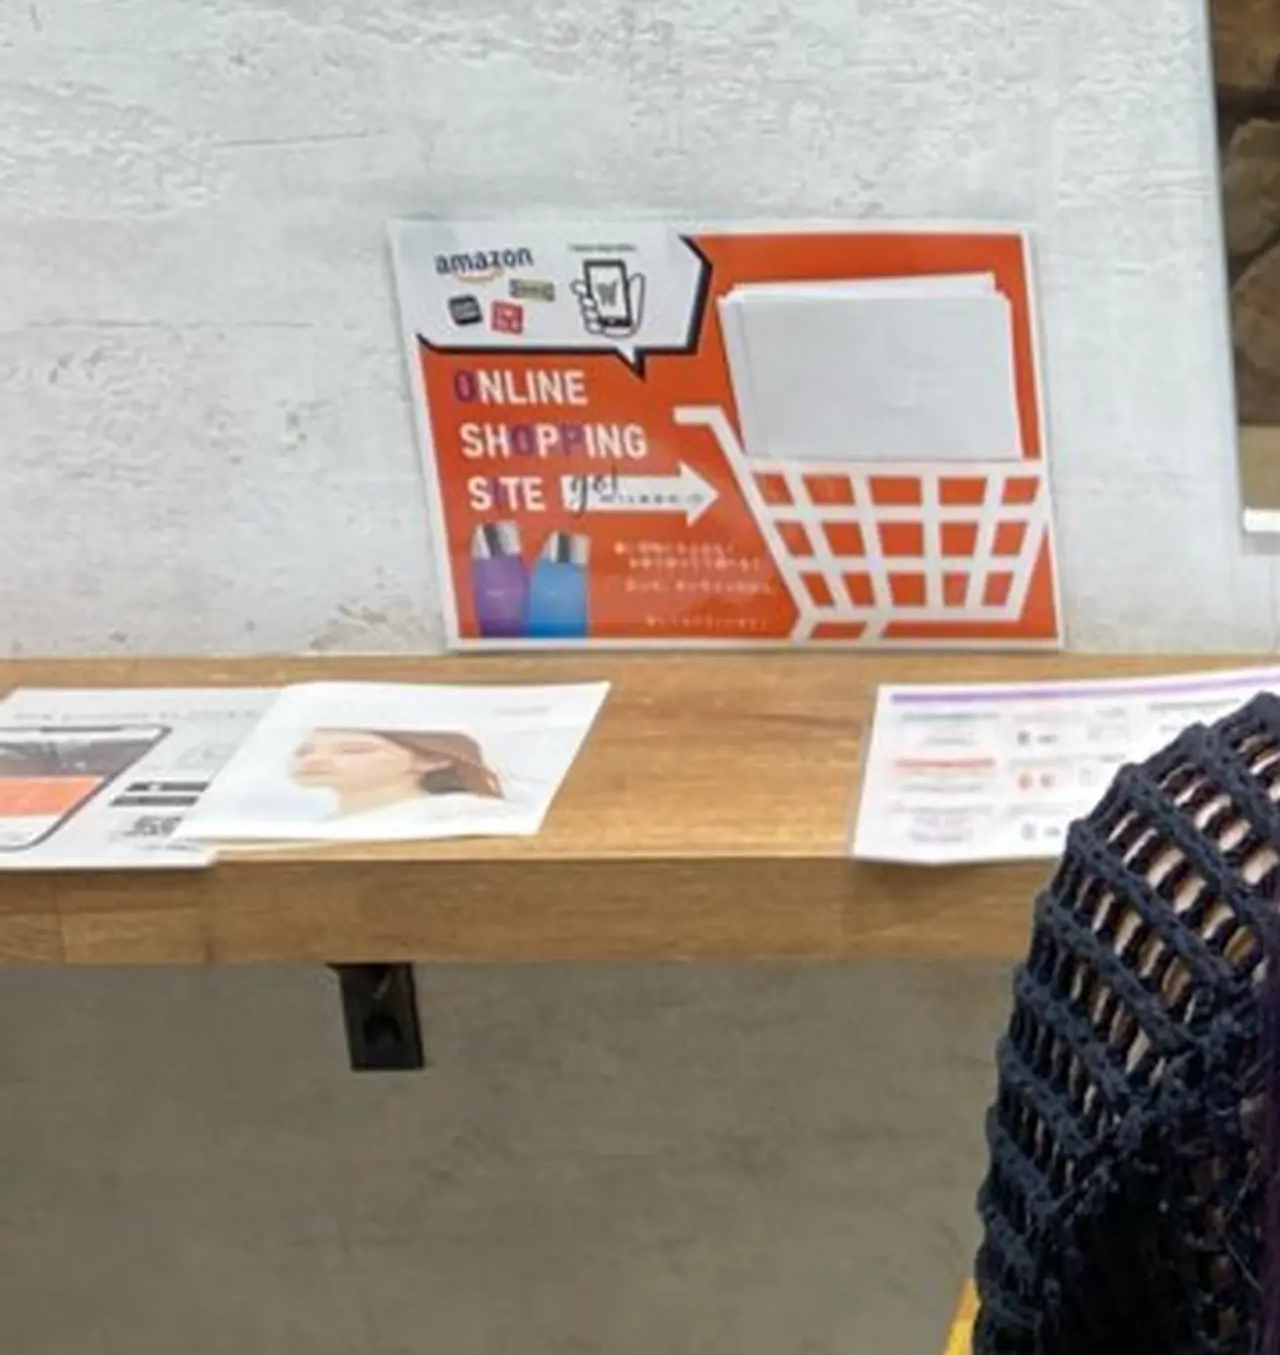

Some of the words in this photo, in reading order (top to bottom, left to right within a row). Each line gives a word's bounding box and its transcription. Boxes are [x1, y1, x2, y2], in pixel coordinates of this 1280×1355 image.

[434, 247, 535, 276] amazon
[454, 368, 590, 407] ONLINE
[459, 421, 649, 460] SHOPPING
[467, 474, 546, 512] SITE
